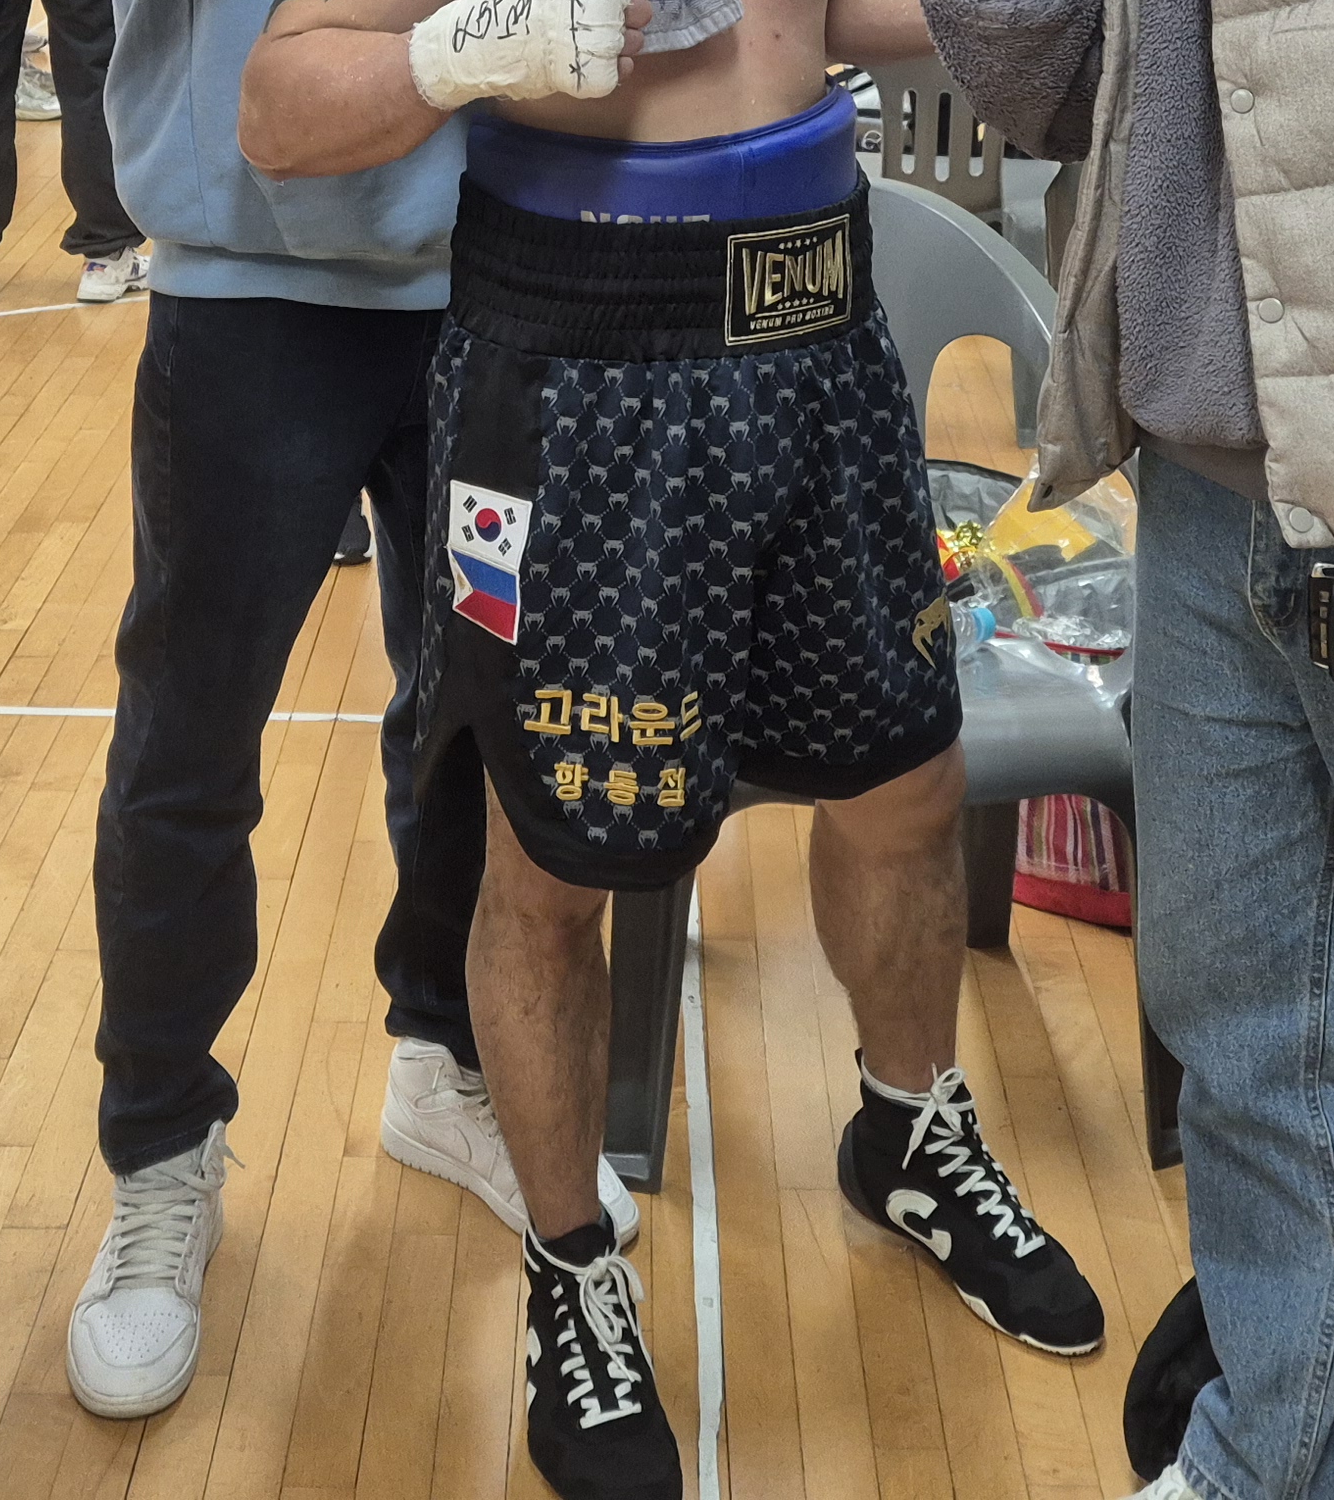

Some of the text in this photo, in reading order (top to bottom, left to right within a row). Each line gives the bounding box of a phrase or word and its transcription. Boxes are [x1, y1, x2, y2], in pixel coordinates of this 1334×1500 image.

[742, 229, 845, 316] VENUM
[749, 304, 835, 331] VENUM PRO BOXING
[523, 688, 703, 746] 고라운드
